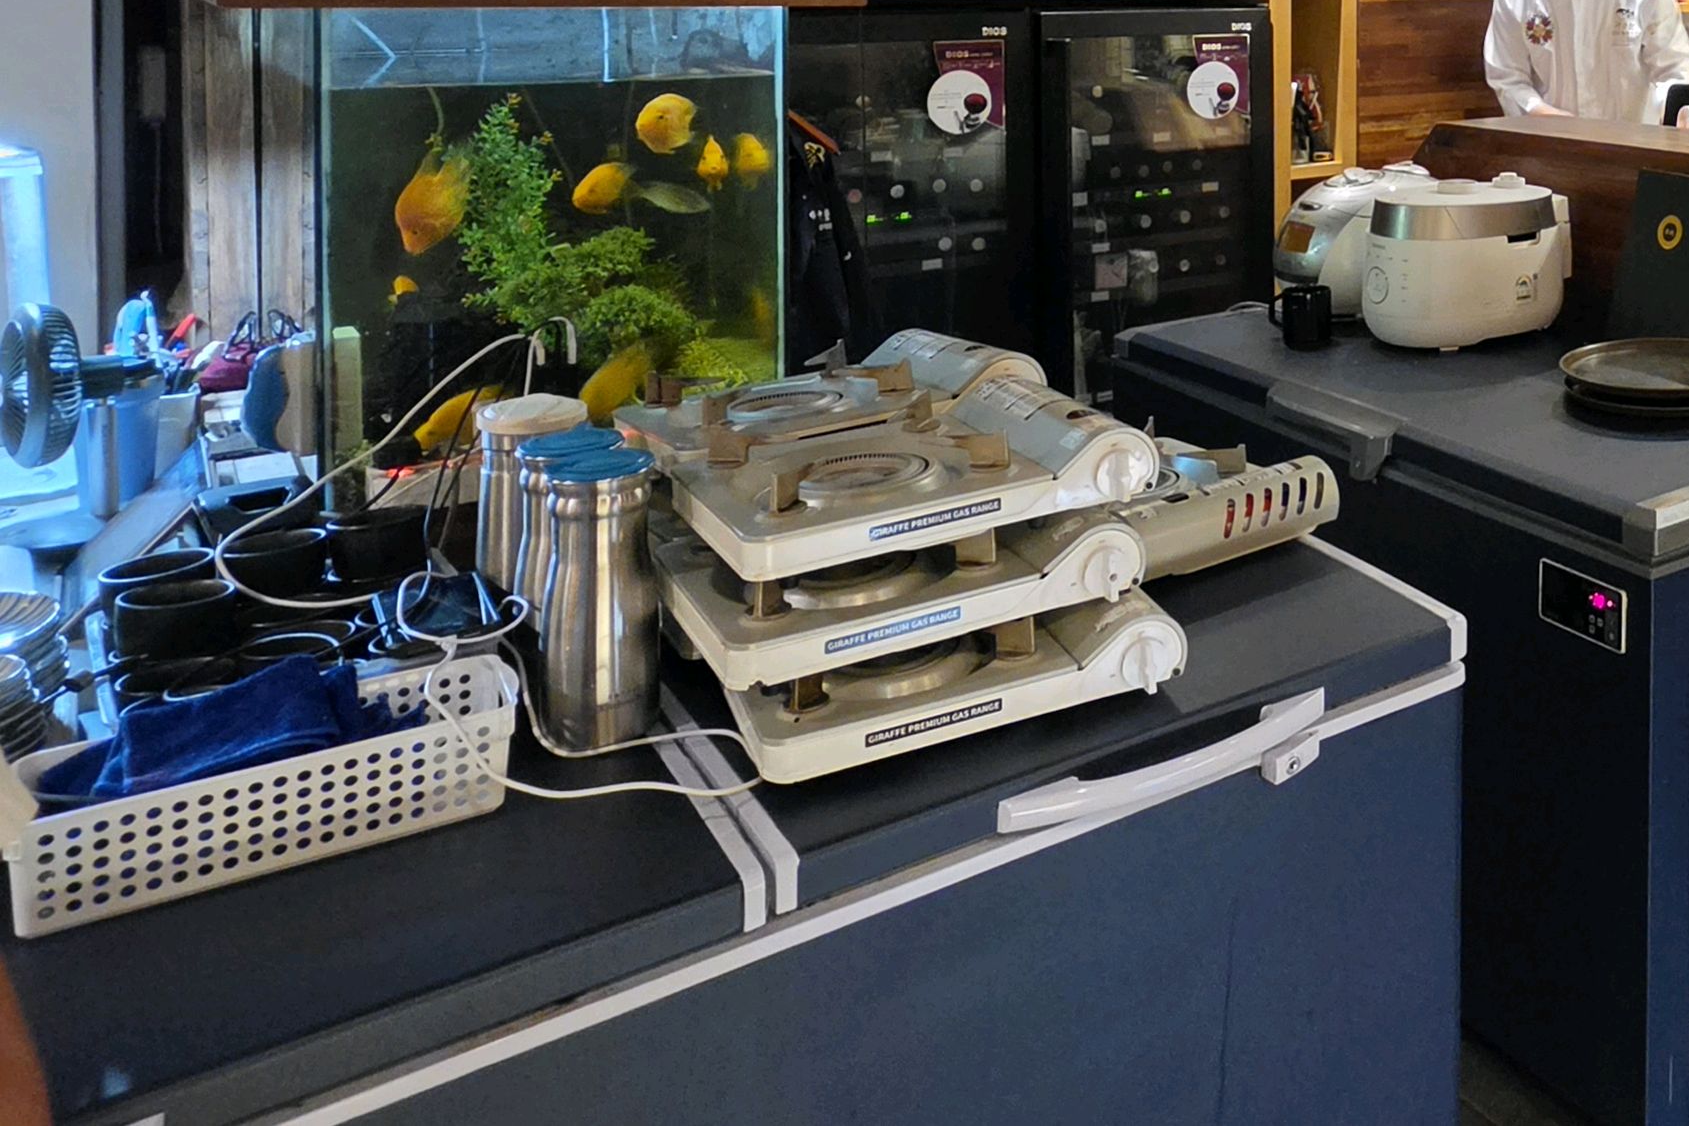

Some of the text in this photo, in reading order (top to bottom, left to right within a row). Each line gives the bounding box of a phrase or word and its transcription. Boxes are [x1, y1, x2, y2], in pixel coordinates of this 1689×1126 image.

[982, 26, 1007, 36] DIOS
[871, 500, 999, 538] GIRAFFE PREMIUM GAS RANGE
[827, 609, 959, 650] GIRAFFE PREMIUM GAS RANGE
[868, 701, 1000, 744] GIRAFFE PREMIUM GAS RANGE
